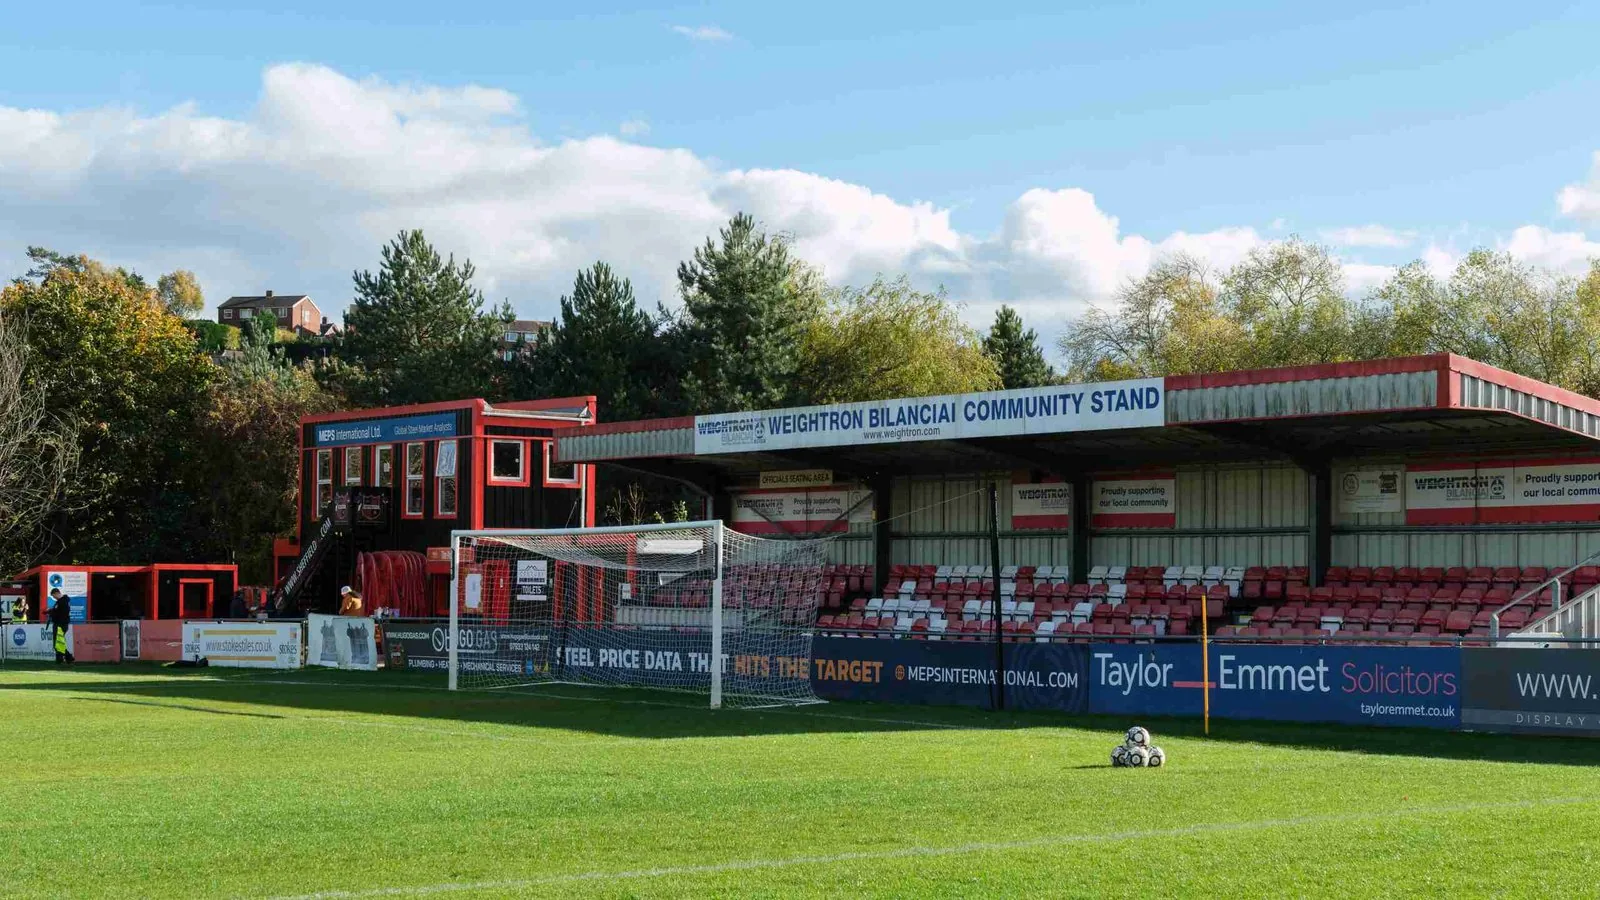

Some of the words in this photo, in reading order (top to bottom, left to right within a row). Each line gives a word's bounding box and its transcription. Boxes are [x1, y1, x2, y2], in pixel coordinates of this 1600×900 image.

[768, 409, 863, 435] WEIGHTRON
[869, 402, 956, 428] BILANCIAI
[964, 393, 1084, 422] COMMUNITY
[1091, 386, 1159, 413] STAND
[318, 430, 335, 442] MEPS
[336, 426, 370, 440] International
[698, 419, 753, 435] WEIGHTRON
[863, 427, 941, 440] www.weightron.com
[1414, 475, 1489, 490] WEIGHTRON
[1525, 473, 1561, 484] Proudly
[1101, 486, 1127, 496] Proudly
[1128, 486, 1165, 496] supporting
[1523, 489, 1539, 497] our
[1542, 486, 1565, 497] local
[1112, 499, 1129, 507] local
[1130, 499, 1169, 508] community
[279, 640, 298, 654] stokes
[408, 659, 435, 669] PLUMBING
[599, 648, 640, 669] PRICE
[644, 650, 683, 671] DATA
[735, 655, 769, 677] HITS
[776, 656, 810, 679] THE
[815, 658, 884, 683] TARGET
[908, 665, 1079, 689] MEPSINTERNAIONAL.COM
[1094, 653, 1173, 696] Taylor
[1219, 654, 1330, 693] Emmet
[1341, 662, 1457, 696] Solicitors
[1361, 702, 1455, 717] tayloremmet.co.uk
[1516, 713, 1585, 726] DISPLAY
